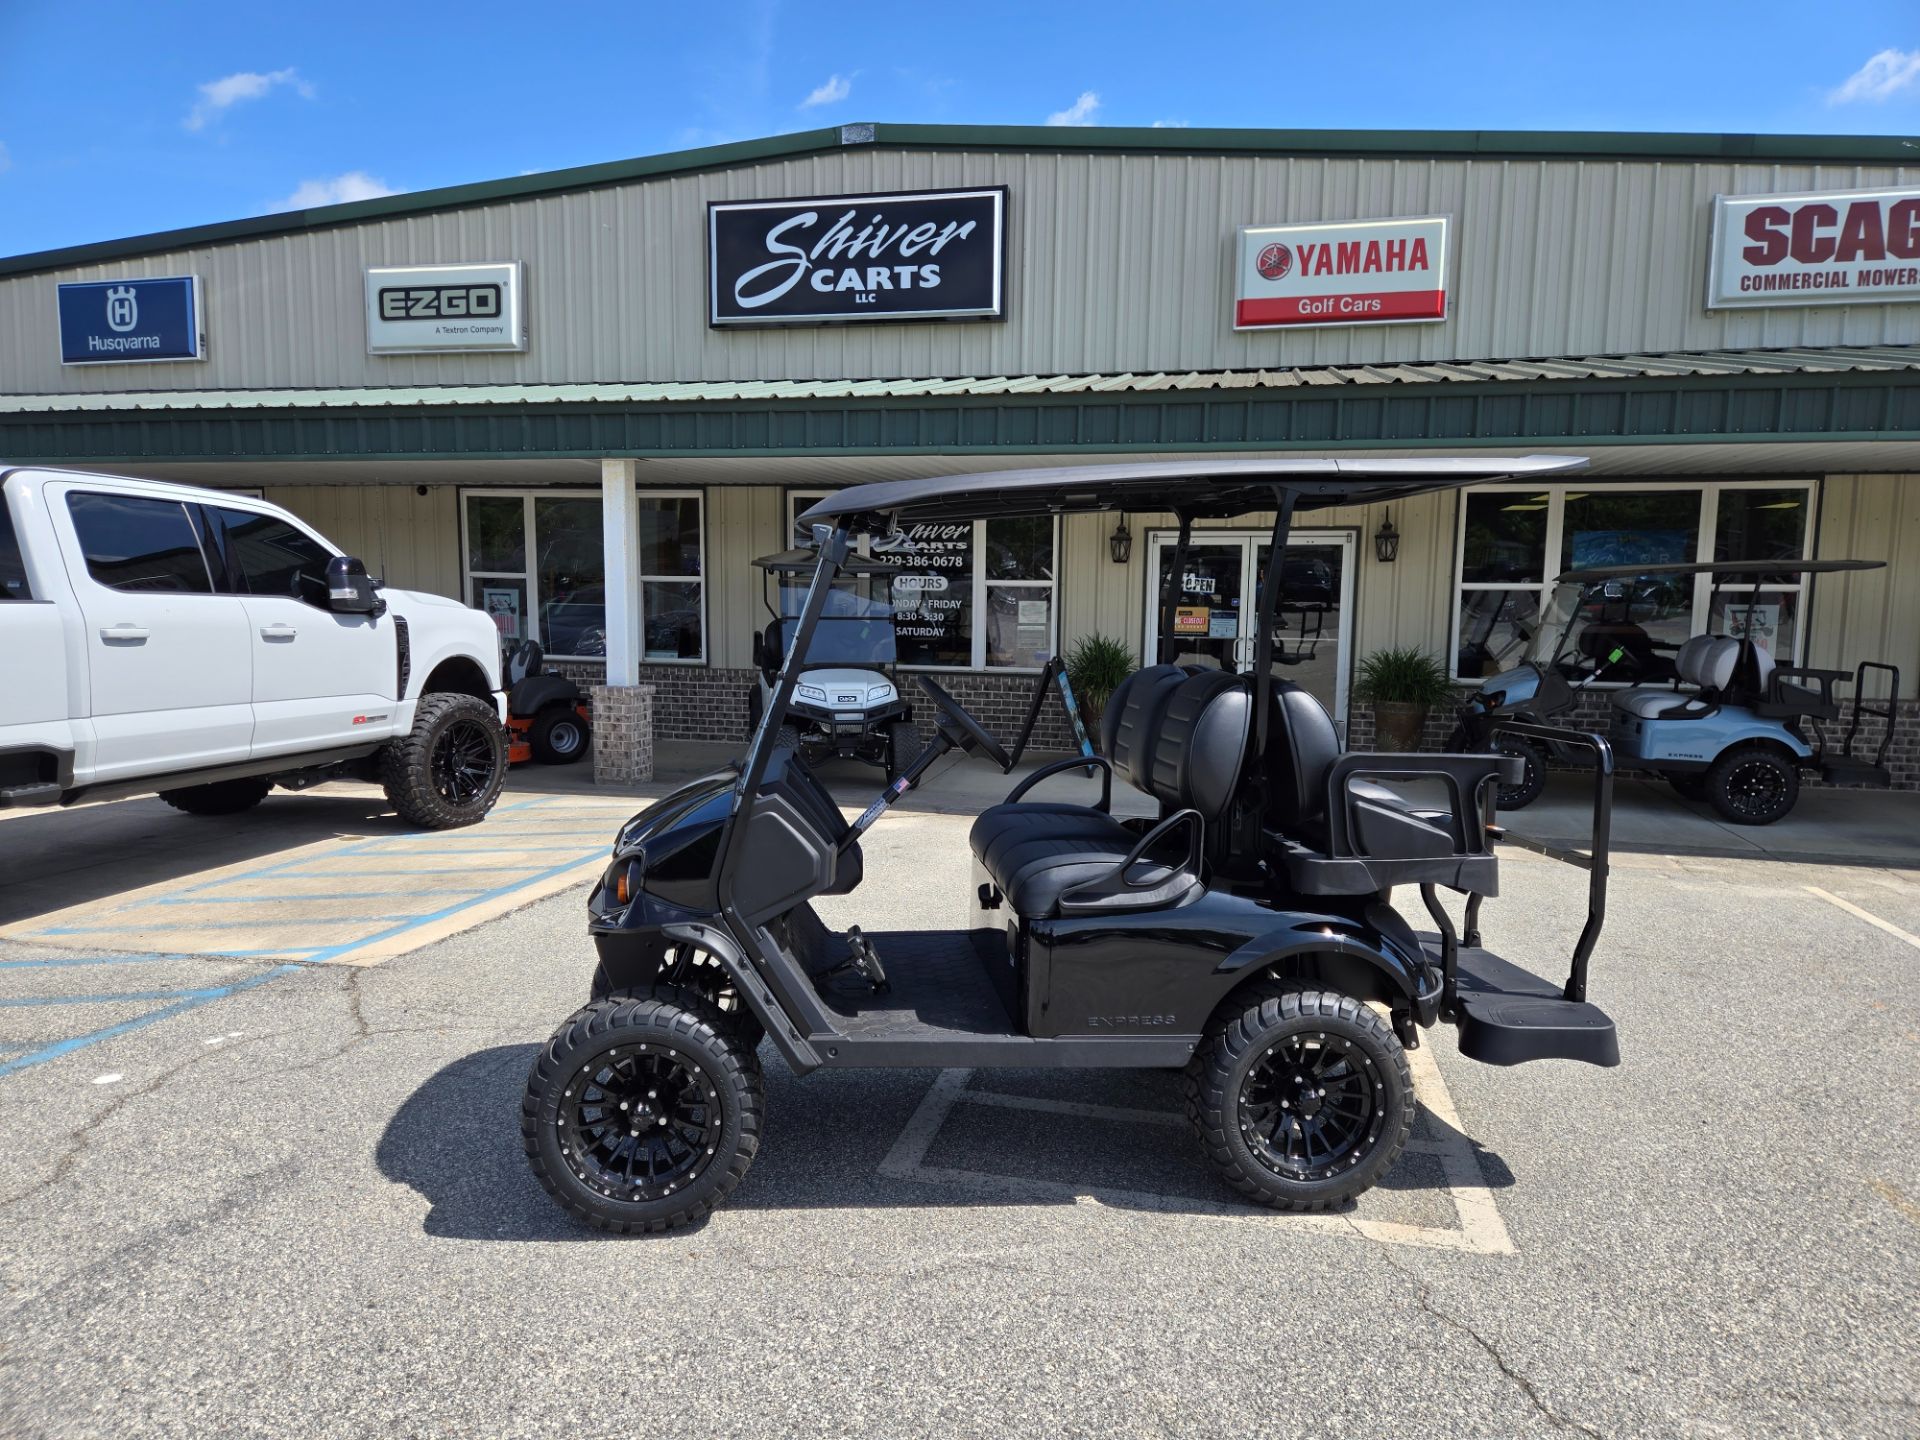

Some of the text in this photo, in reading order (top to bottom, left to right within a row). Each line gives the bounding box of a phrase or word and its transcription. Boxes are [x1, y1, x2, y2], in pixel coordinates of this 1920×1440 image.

[1742, 198, 1920, 267] SCAG
[734, 209, 977, 309] Shiver
[1296, 237, 1429, 277] YAMAHA
[810, 264, 942, 292] CARTS
[1740, 267, 1920, 292] COMMERCIAL MOWER
[382, 287, 498, 318] EZGO
[855, 293, 877, 303] LLC
[1298, 297, 1381, 314] Golf Cars
[443, 325, 469, 334] Textron
[470, 325, 504, 335] Company
[88, 335, 161, 352] Husqvarna
[902, 541, 968, 550] CARTS
[899, 577, 943, 589] HOURS
[1185, 578, 1213, 592] OPEN
[928, 599, 962, 609] FRIDAY
[897, 611, 917, 621] 8:30
[924, 612, 944, 621] 5:30
[896, 626, 946, 637] SATURDAY
[1088, 1015, 1176, 1027] EXPRESS
